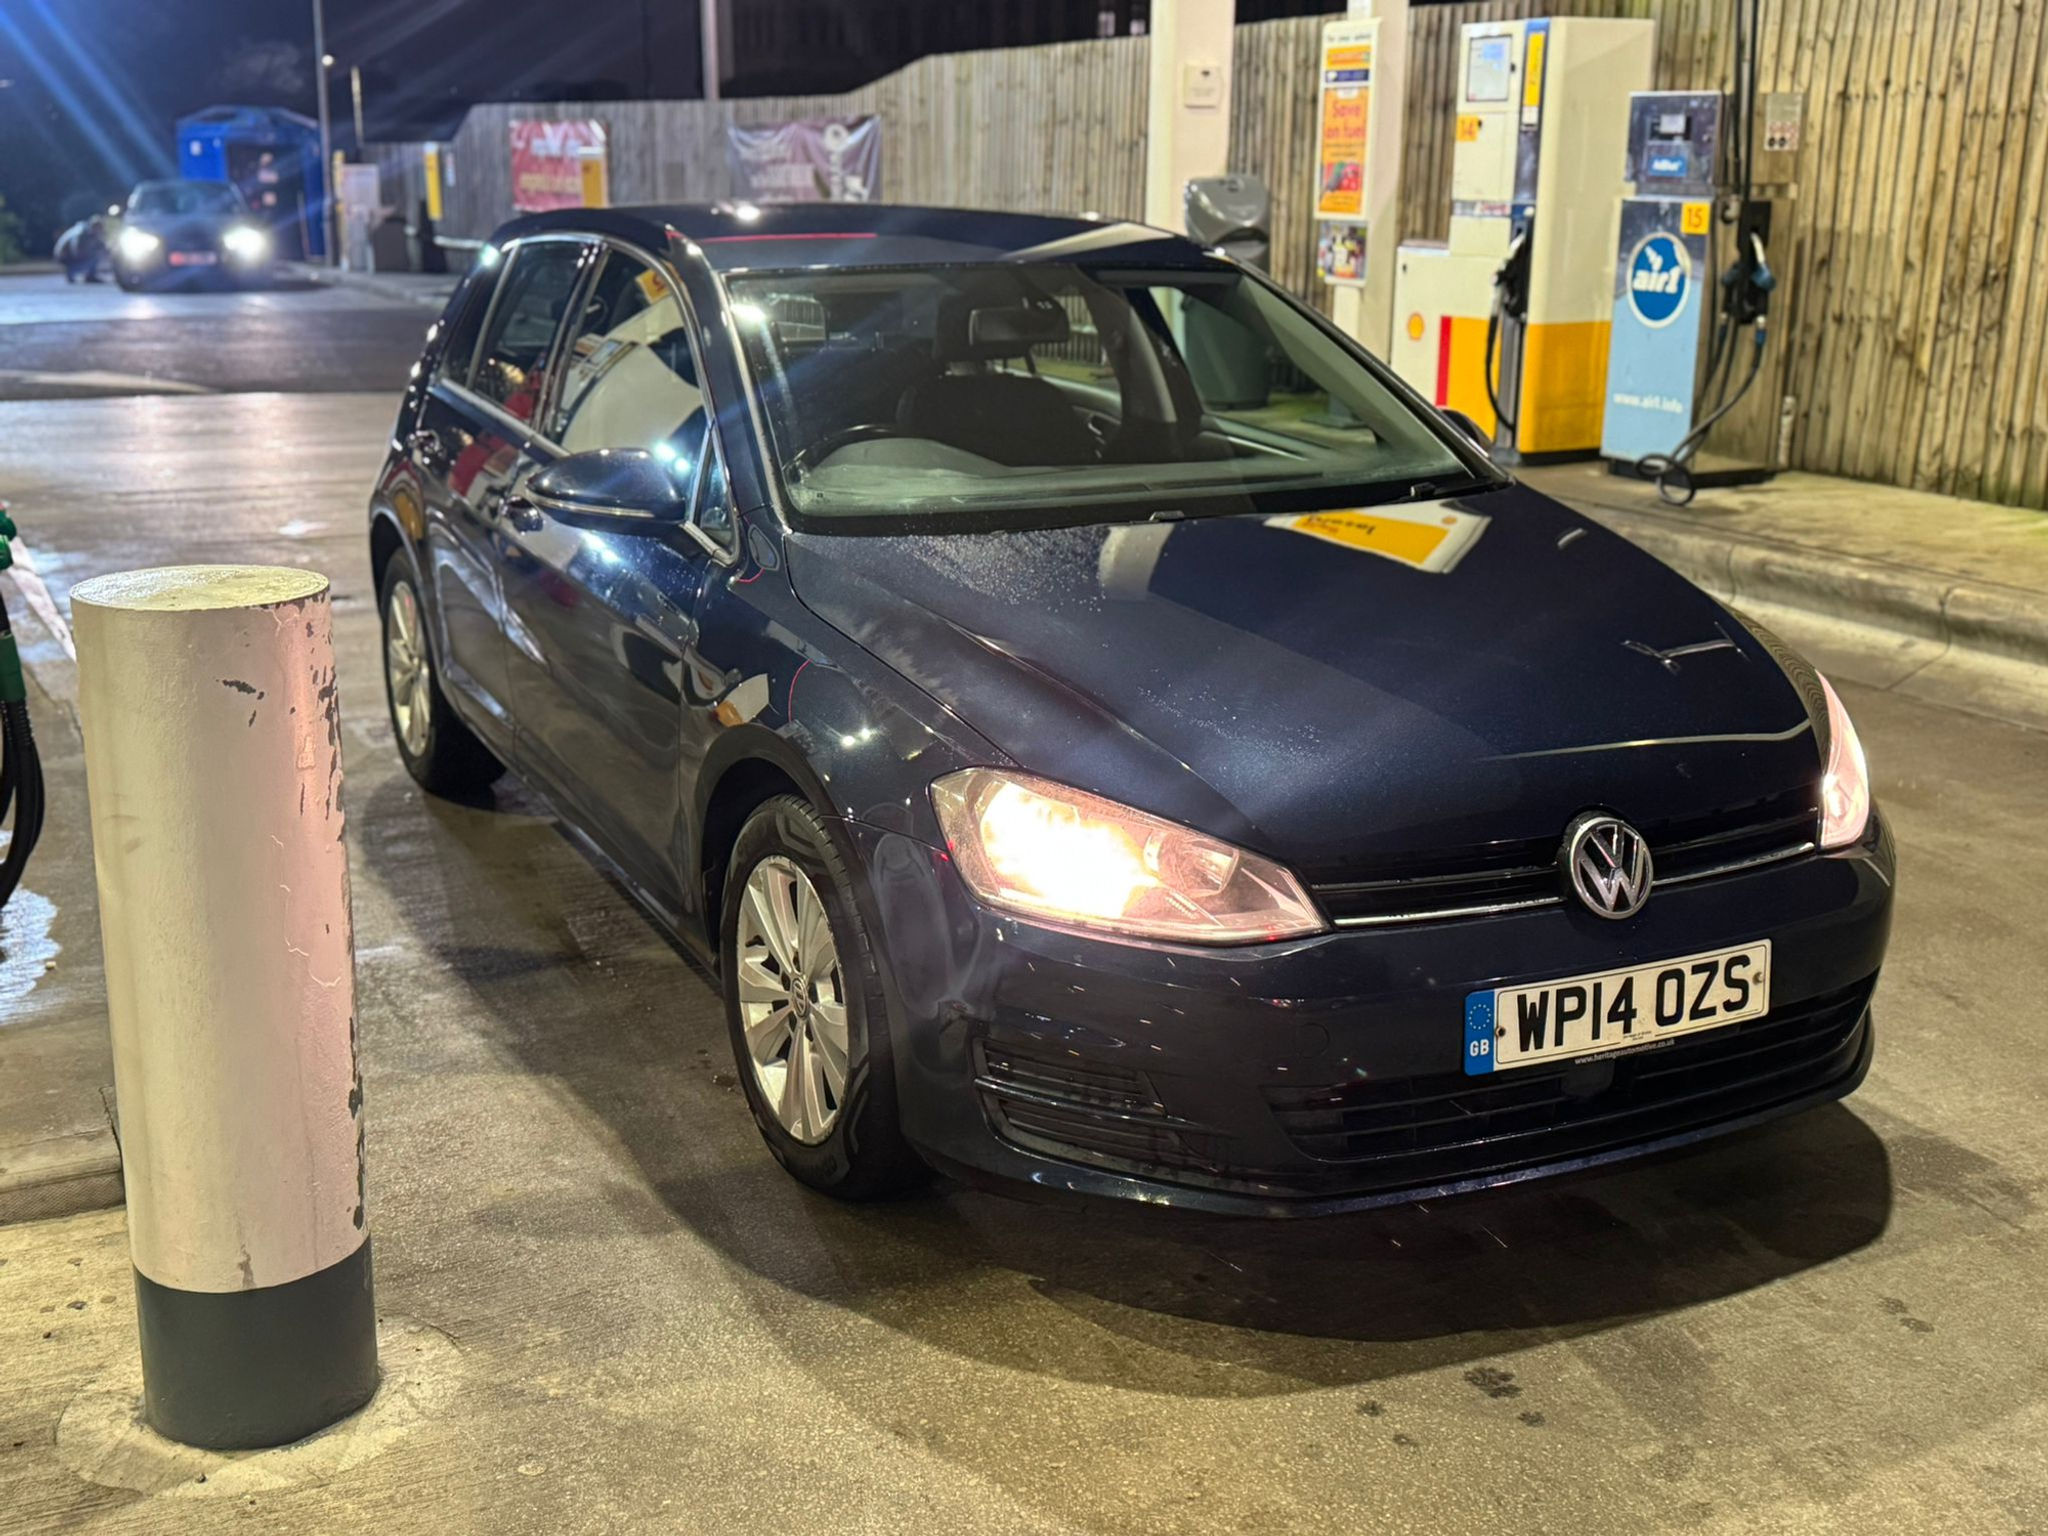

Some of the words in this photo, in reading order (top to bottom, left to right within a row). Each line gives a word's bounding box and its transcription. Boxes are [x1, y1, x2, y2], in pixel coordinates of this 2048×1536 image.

[1333, 101, 1361, 119] Save
[1325, 127, 1339, 138] on
[1343, 119, 1366, 138] fuel
[1460, 118, 1475, 137] 14
[1687, 207, 1703, 228] 15
[1517, 976, 1638, 1052] WP14
[1655, 954, 1751, 1027] OZS
[1470, 1039, 1490, 1057] GB
